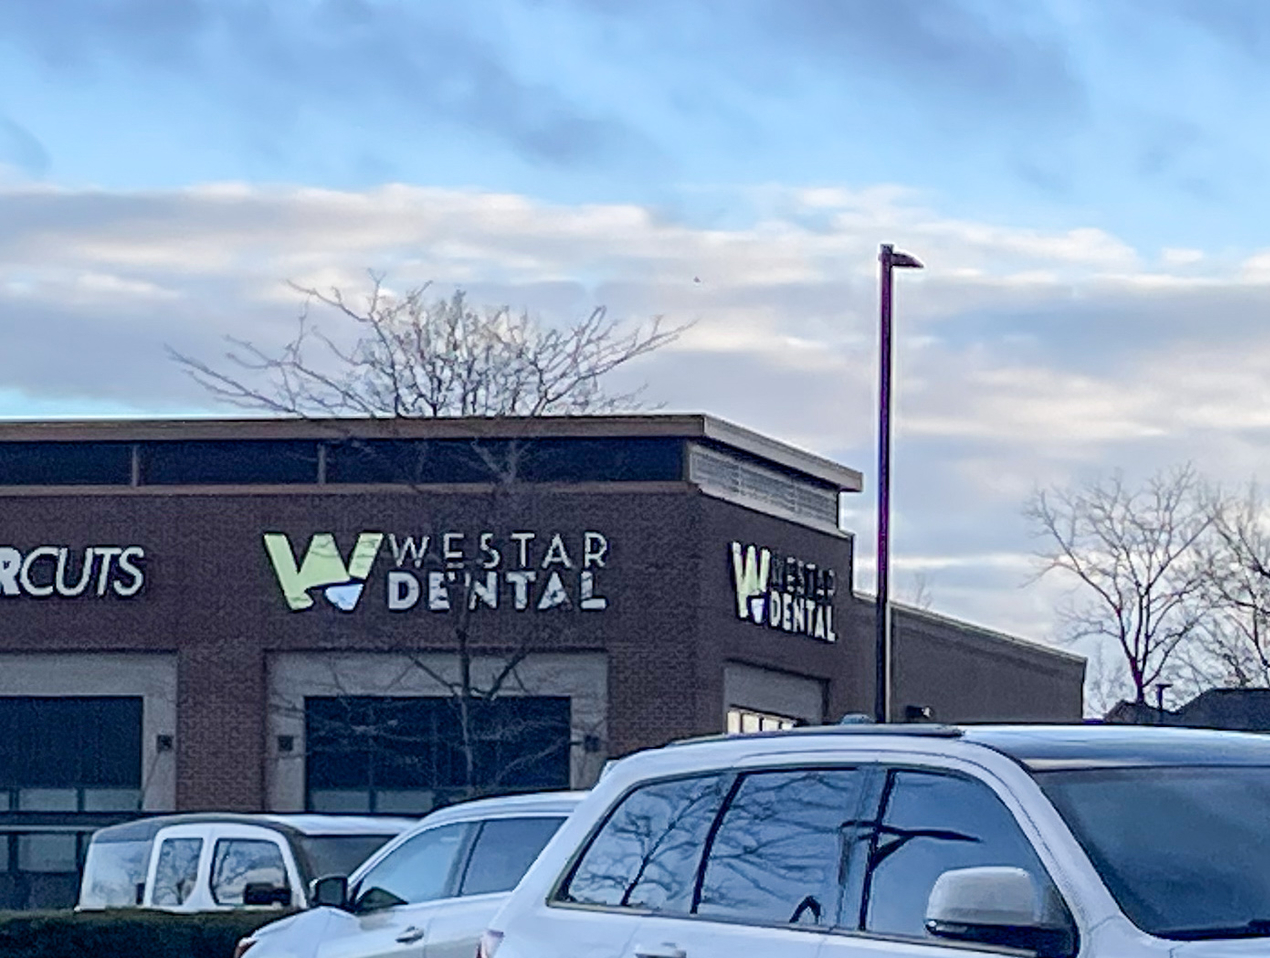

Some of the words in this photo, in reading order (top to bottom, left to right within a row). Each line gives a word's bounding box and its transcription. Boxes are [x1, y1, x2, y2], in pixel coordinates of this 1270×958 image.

[387, 533, 608, 568] WESTAR
[387, 570, 607, 610] DENTAL
[769, 590, 836, 642] DENTAL
